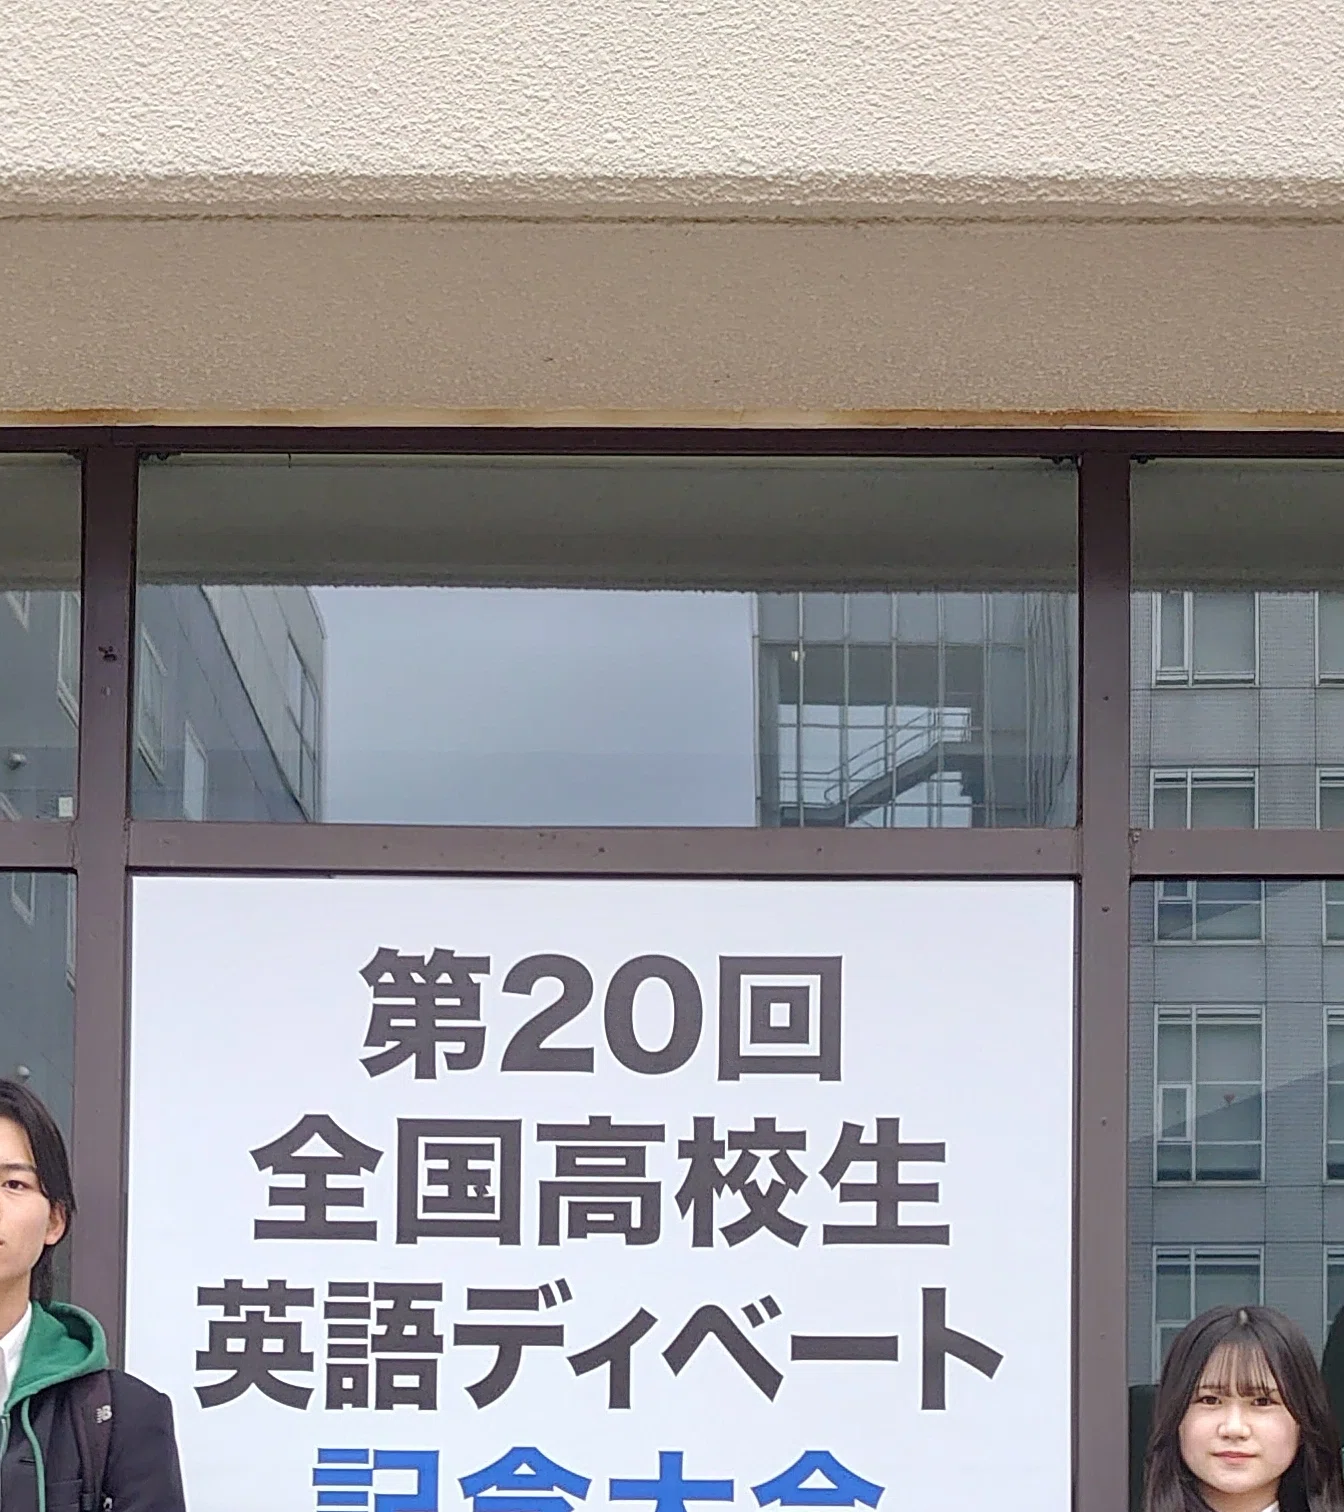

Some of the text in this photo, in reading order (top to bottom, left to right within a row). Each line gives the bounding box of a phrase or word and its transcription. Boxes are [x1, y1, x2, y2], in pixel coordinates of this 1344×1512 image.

[359, 947, 842, 1081] 第20回
[249, 1114, 950, 1247] 全国高校生
[194, 1278, 1003, 1410] 英語ディベート
